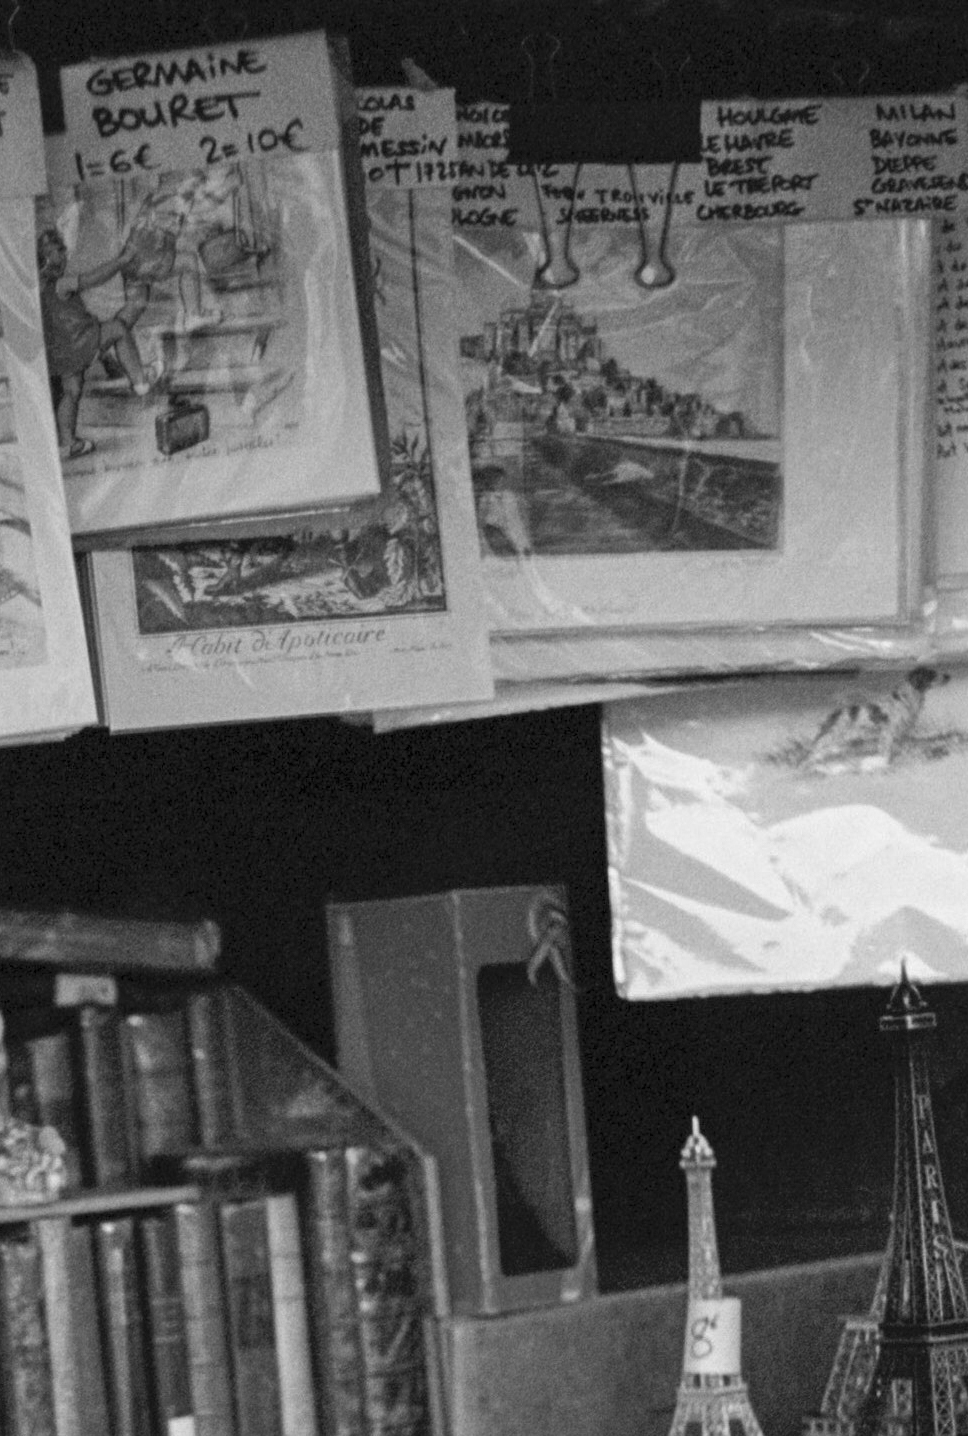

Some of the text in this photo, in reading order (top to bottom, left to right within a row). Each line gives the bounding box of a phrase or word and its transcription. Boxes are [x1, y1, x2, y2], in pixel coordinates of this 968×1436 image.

[357, 93, 416, 112] OLAS
[876, 102, 956, 122] MILAN
[92, 92, 262, 138] BOURET
[869, 128, 958, 149] BAYONNE
[705, 155, 774, 177] BREST
[871, 154, 938, 175] DIEPPE
